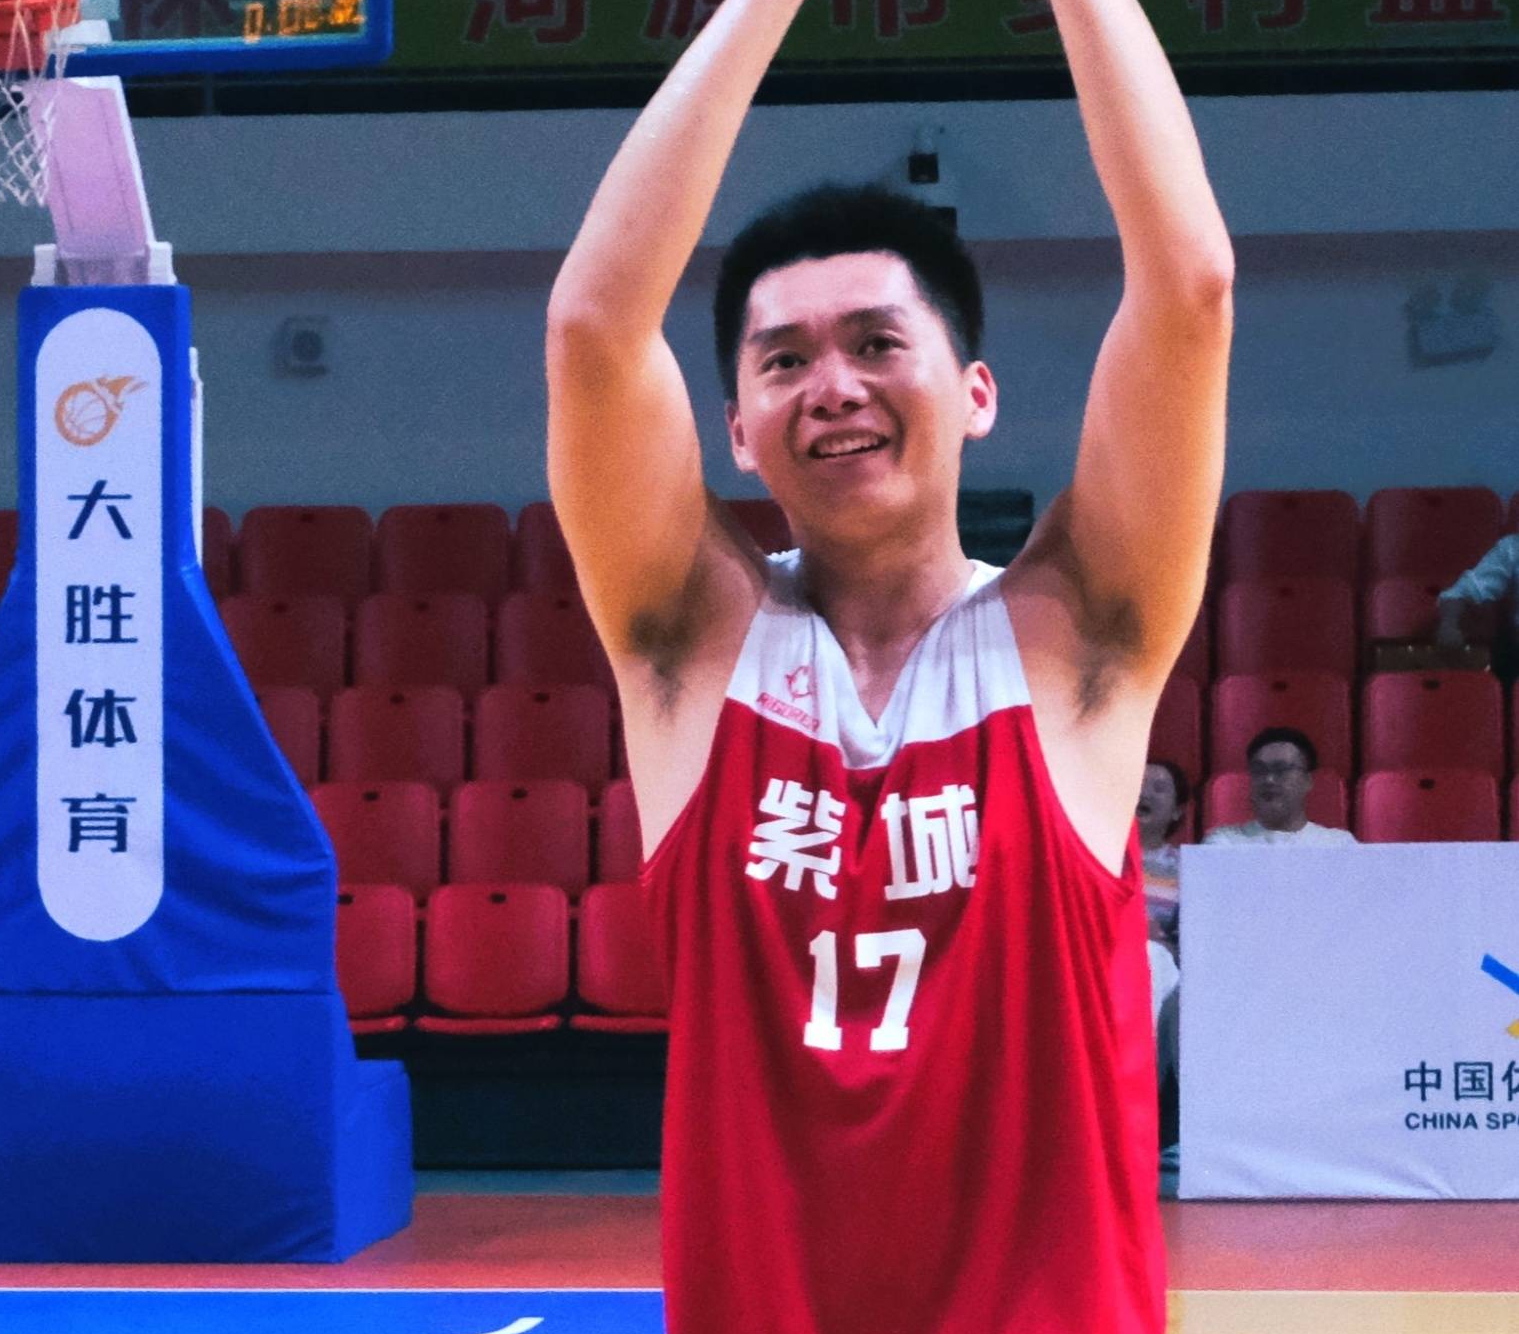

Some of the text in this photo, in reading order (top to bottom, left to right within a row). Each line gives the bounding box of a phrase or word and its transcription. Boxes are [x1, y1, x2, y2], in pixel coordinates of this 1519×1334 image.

[61, 479, 138, 854] 大胜体育
[744, 777, 978, 902] 紫城
[803, 929, 926, 1052] 17
[1405, 1112, 1519, 1130] CHINA SP
